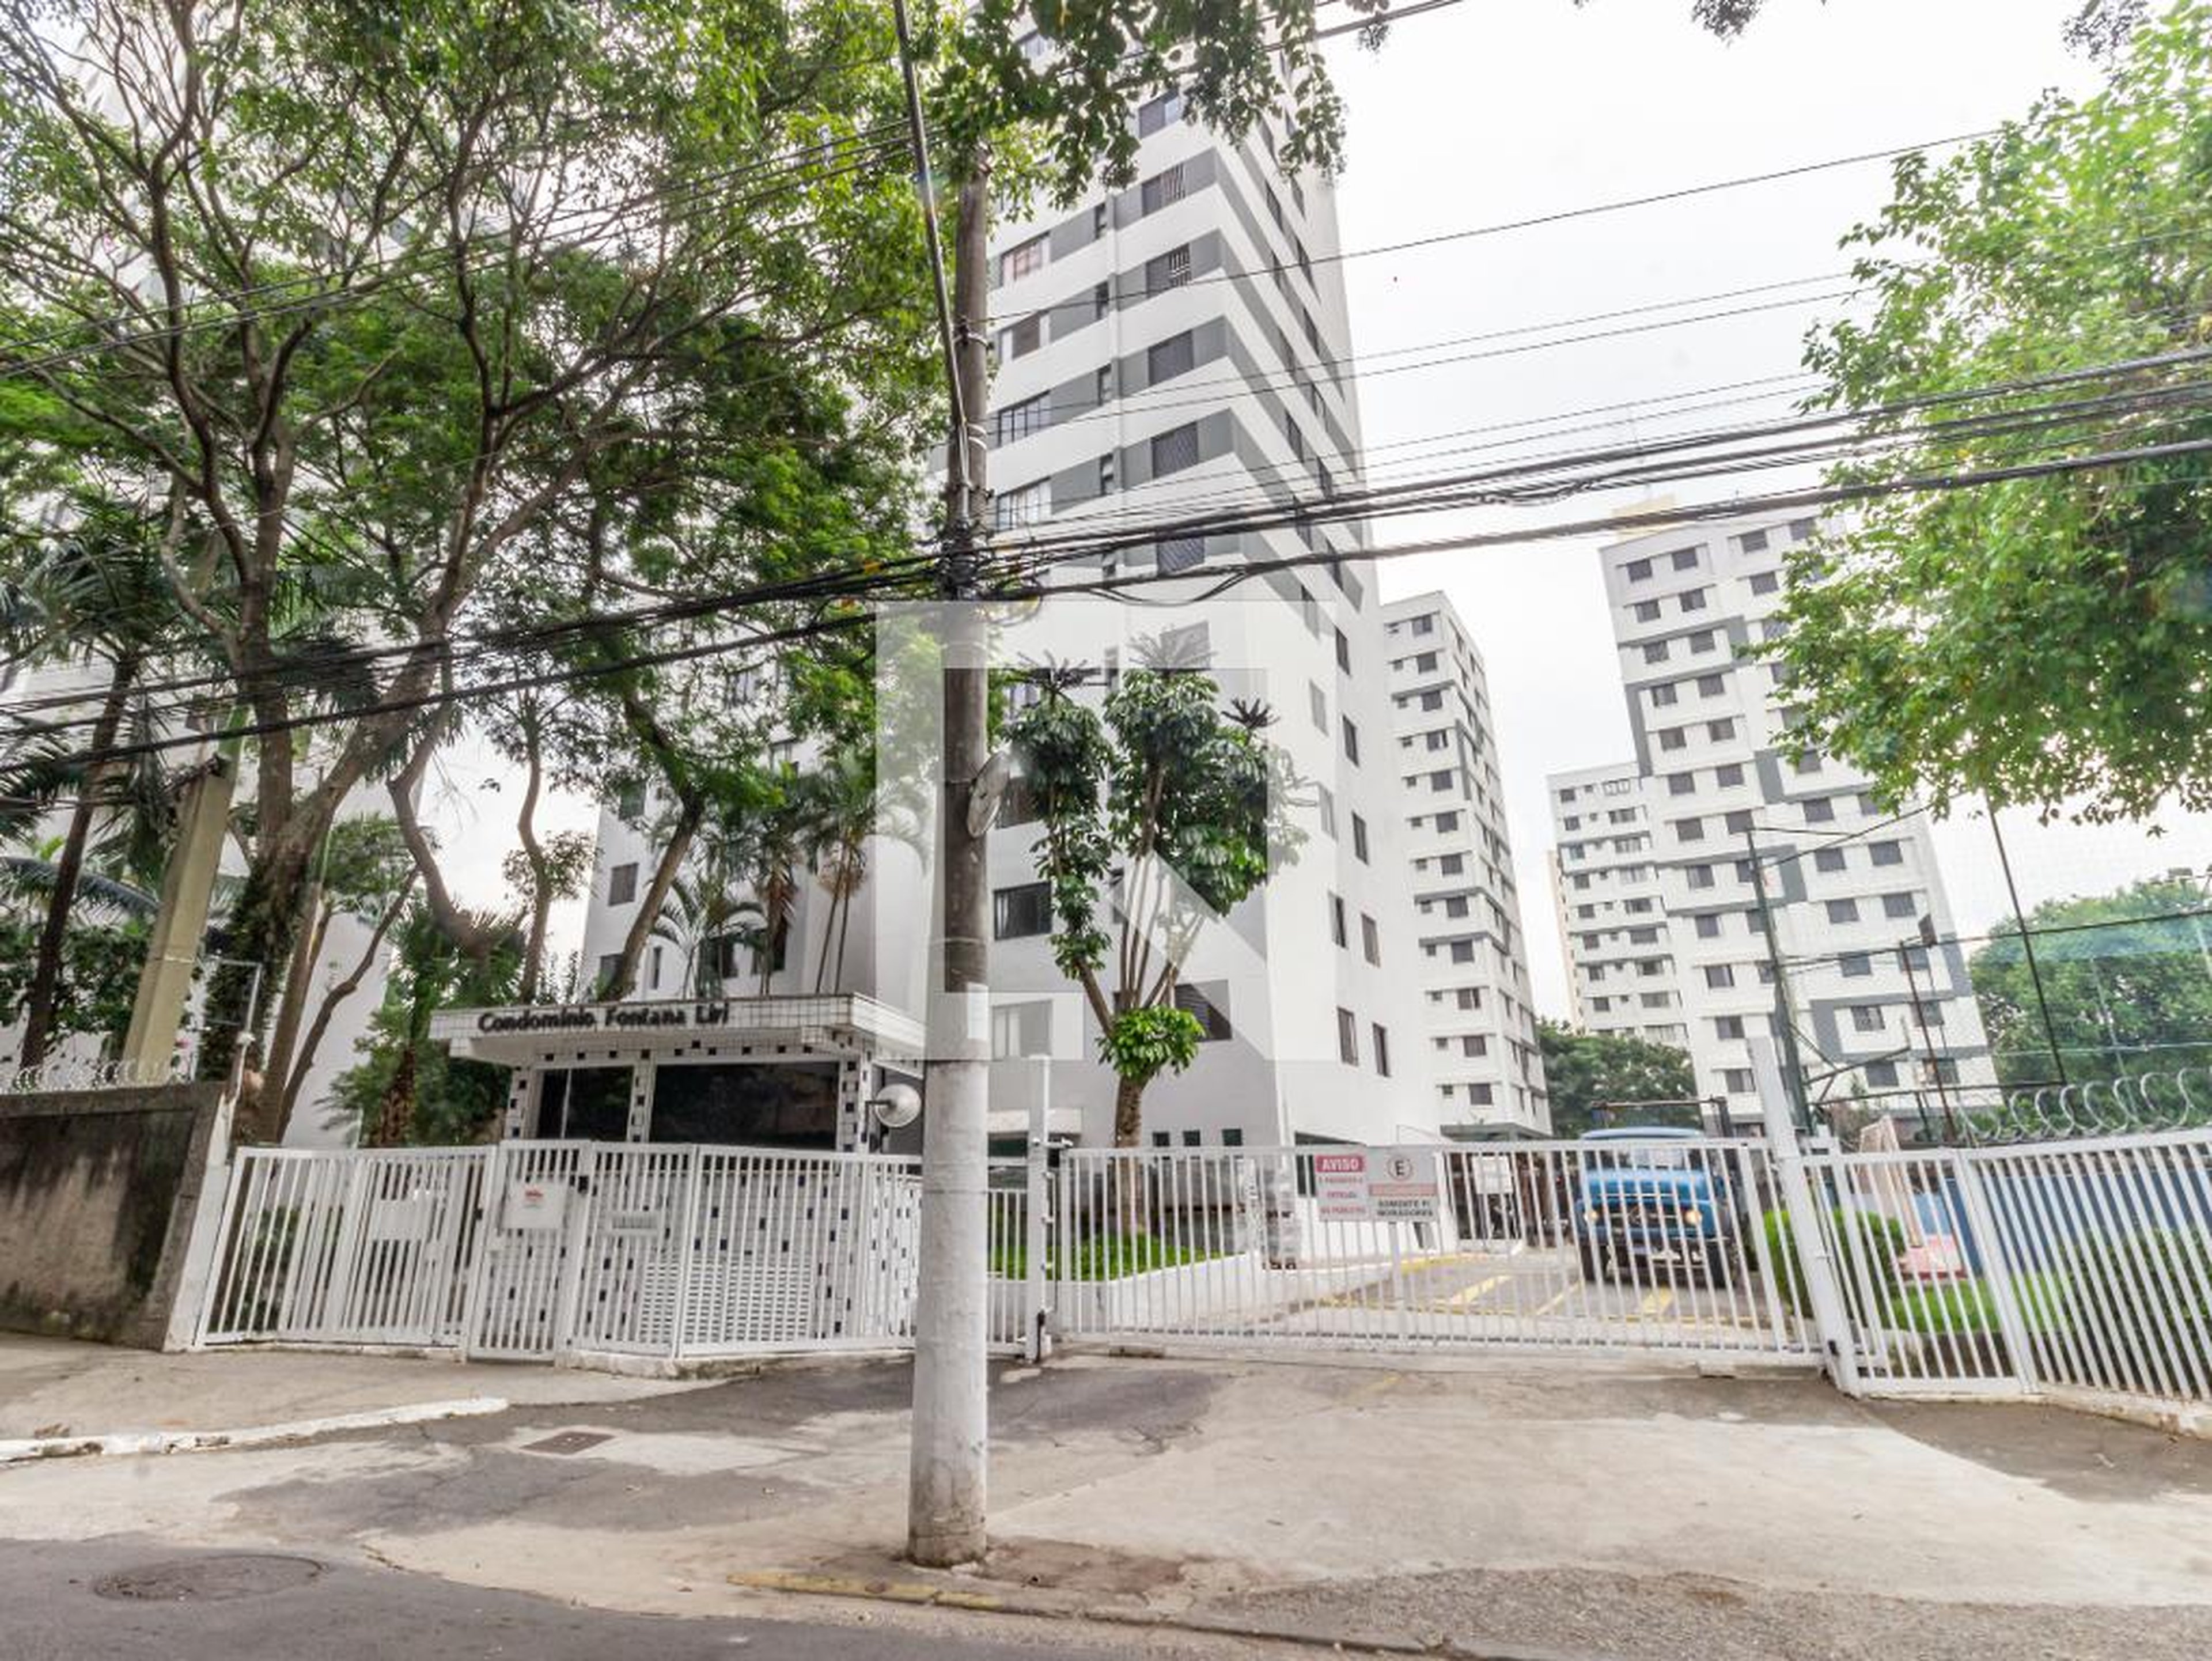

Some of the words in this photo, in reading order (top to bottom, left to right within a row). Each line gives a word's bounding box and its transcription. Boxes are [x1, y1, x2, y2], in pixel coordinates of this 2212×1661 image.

[605, 1007, 687, 1026] Fontana
[695, 1002, 729, 1024] Liri
[1322, 1158, 1359, 1171] AVISO
[1395, 1159, 1406, 1176] E
